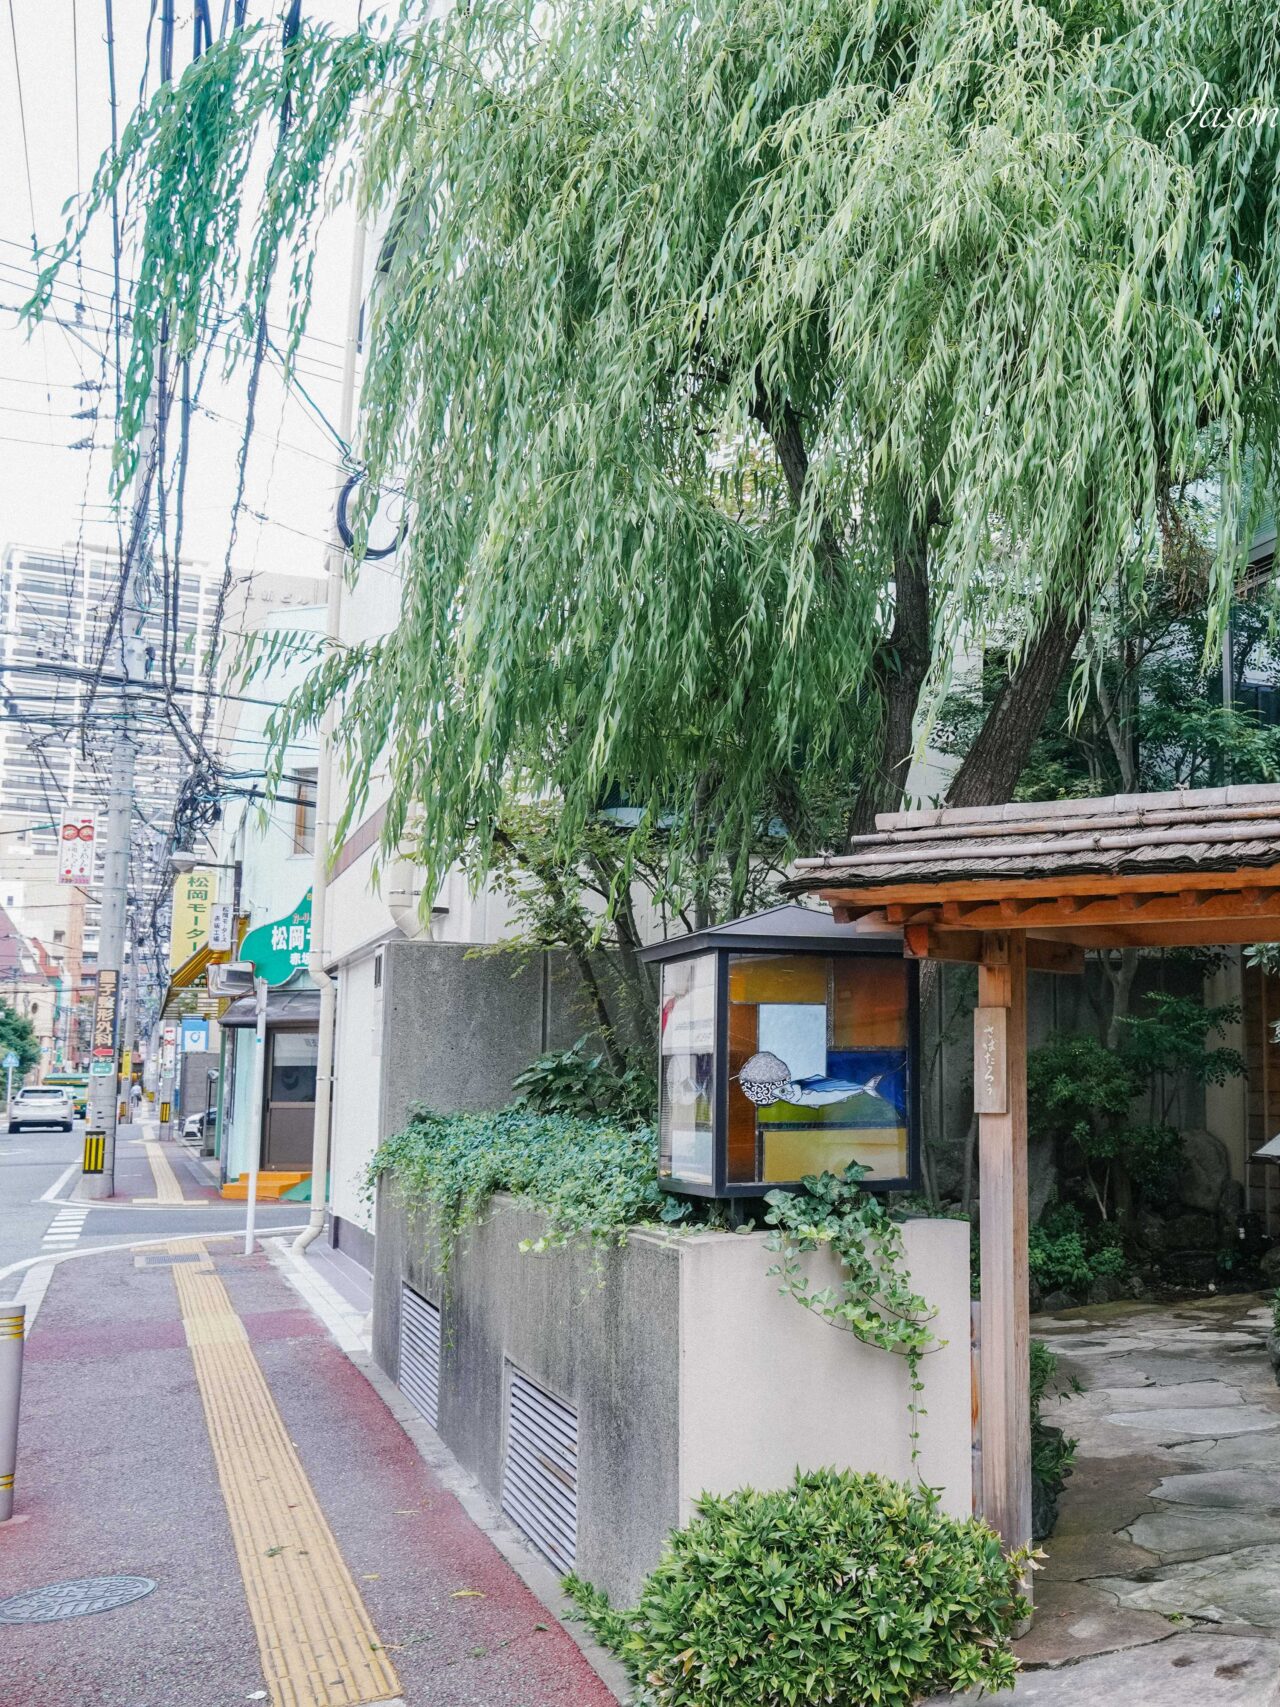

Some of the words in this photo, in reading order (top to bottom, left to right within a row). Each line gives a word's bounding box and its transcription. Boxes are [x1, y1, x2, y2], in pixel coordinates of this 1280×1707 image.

[185, 875, 209, 957] 松岡モーター
[292, 911, 311, 925] カーリ
